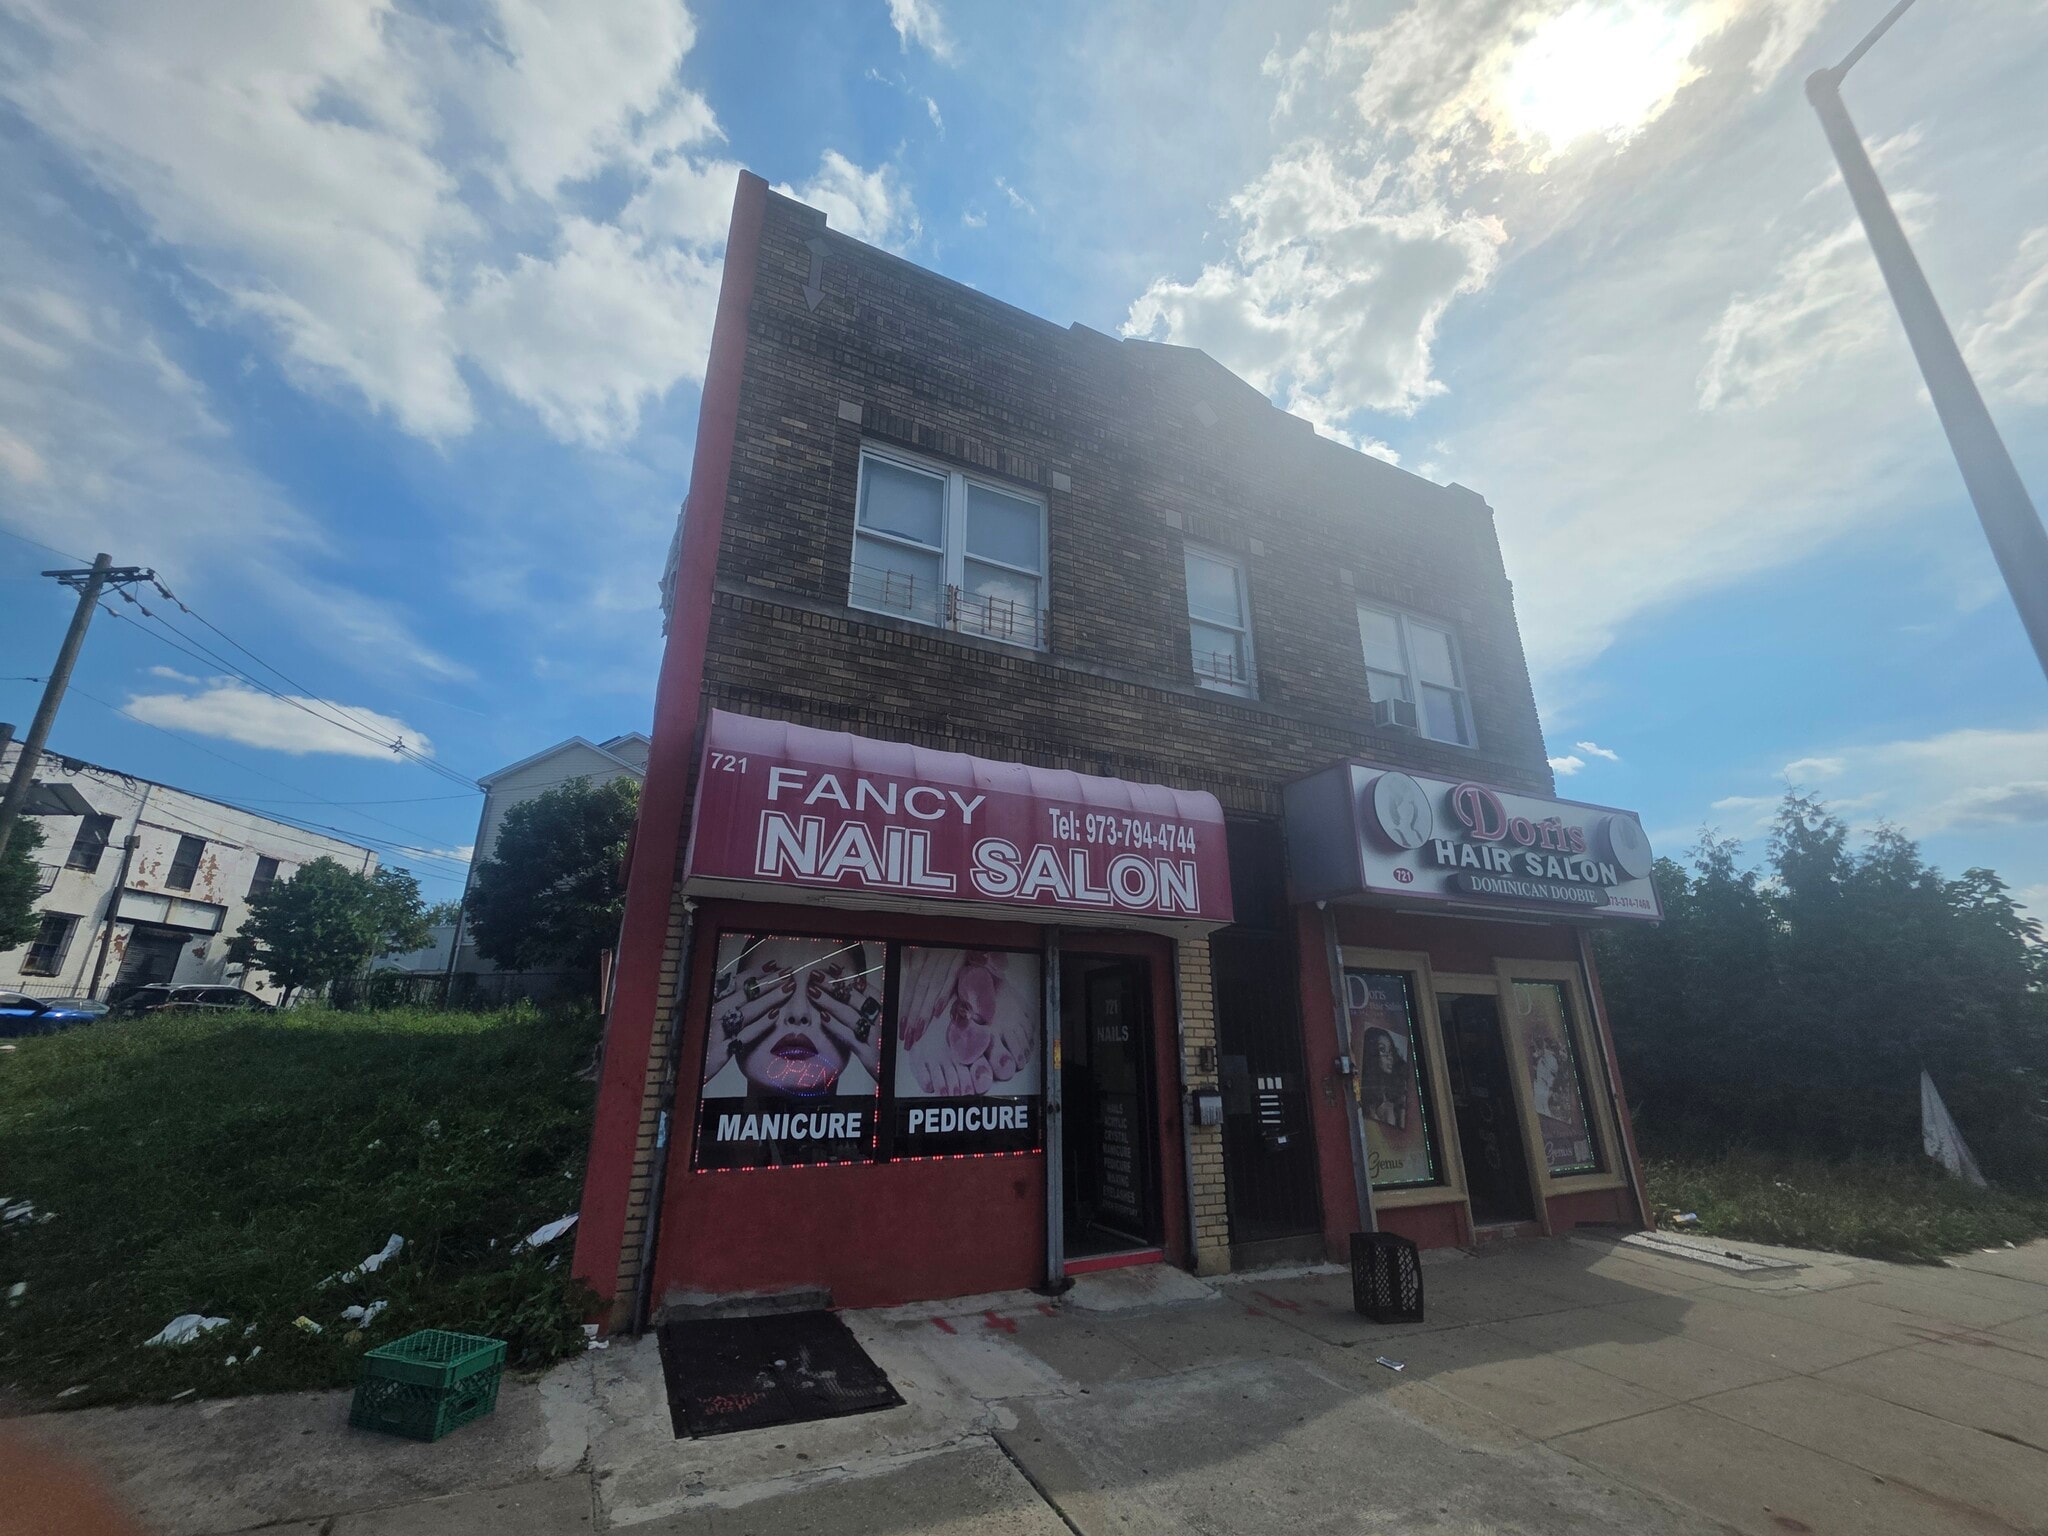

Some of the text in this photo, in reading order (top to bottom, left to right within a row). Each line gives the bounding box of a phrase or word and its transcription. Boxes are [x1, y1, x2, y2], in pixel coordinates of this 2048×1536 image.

[710, 751, 748, 775] 721
[767, 766, 986, 825] FANCY
[1048, 807, 1196, 854] Tel: 973-794-4744
[1453, 781, 1587, 854] Doris
[755, 810, 1201, 914] NAIL SALON
[1395, 869, 1413, 883] 721
[1434, 839, 1618, 887] HAIR SALON
[1470, 875, 1598, 904] DOMINICAN DOOBIE
[1097, 1024, 1129, 1043] NAILS
[766, 1056, 839, 1091] OPEN
[716, 1111, 863, 1142] MANICURE
[908, 1105, 1029, 1134] PEDICURE
[1368, 1151, 1404, 1179] Genus
